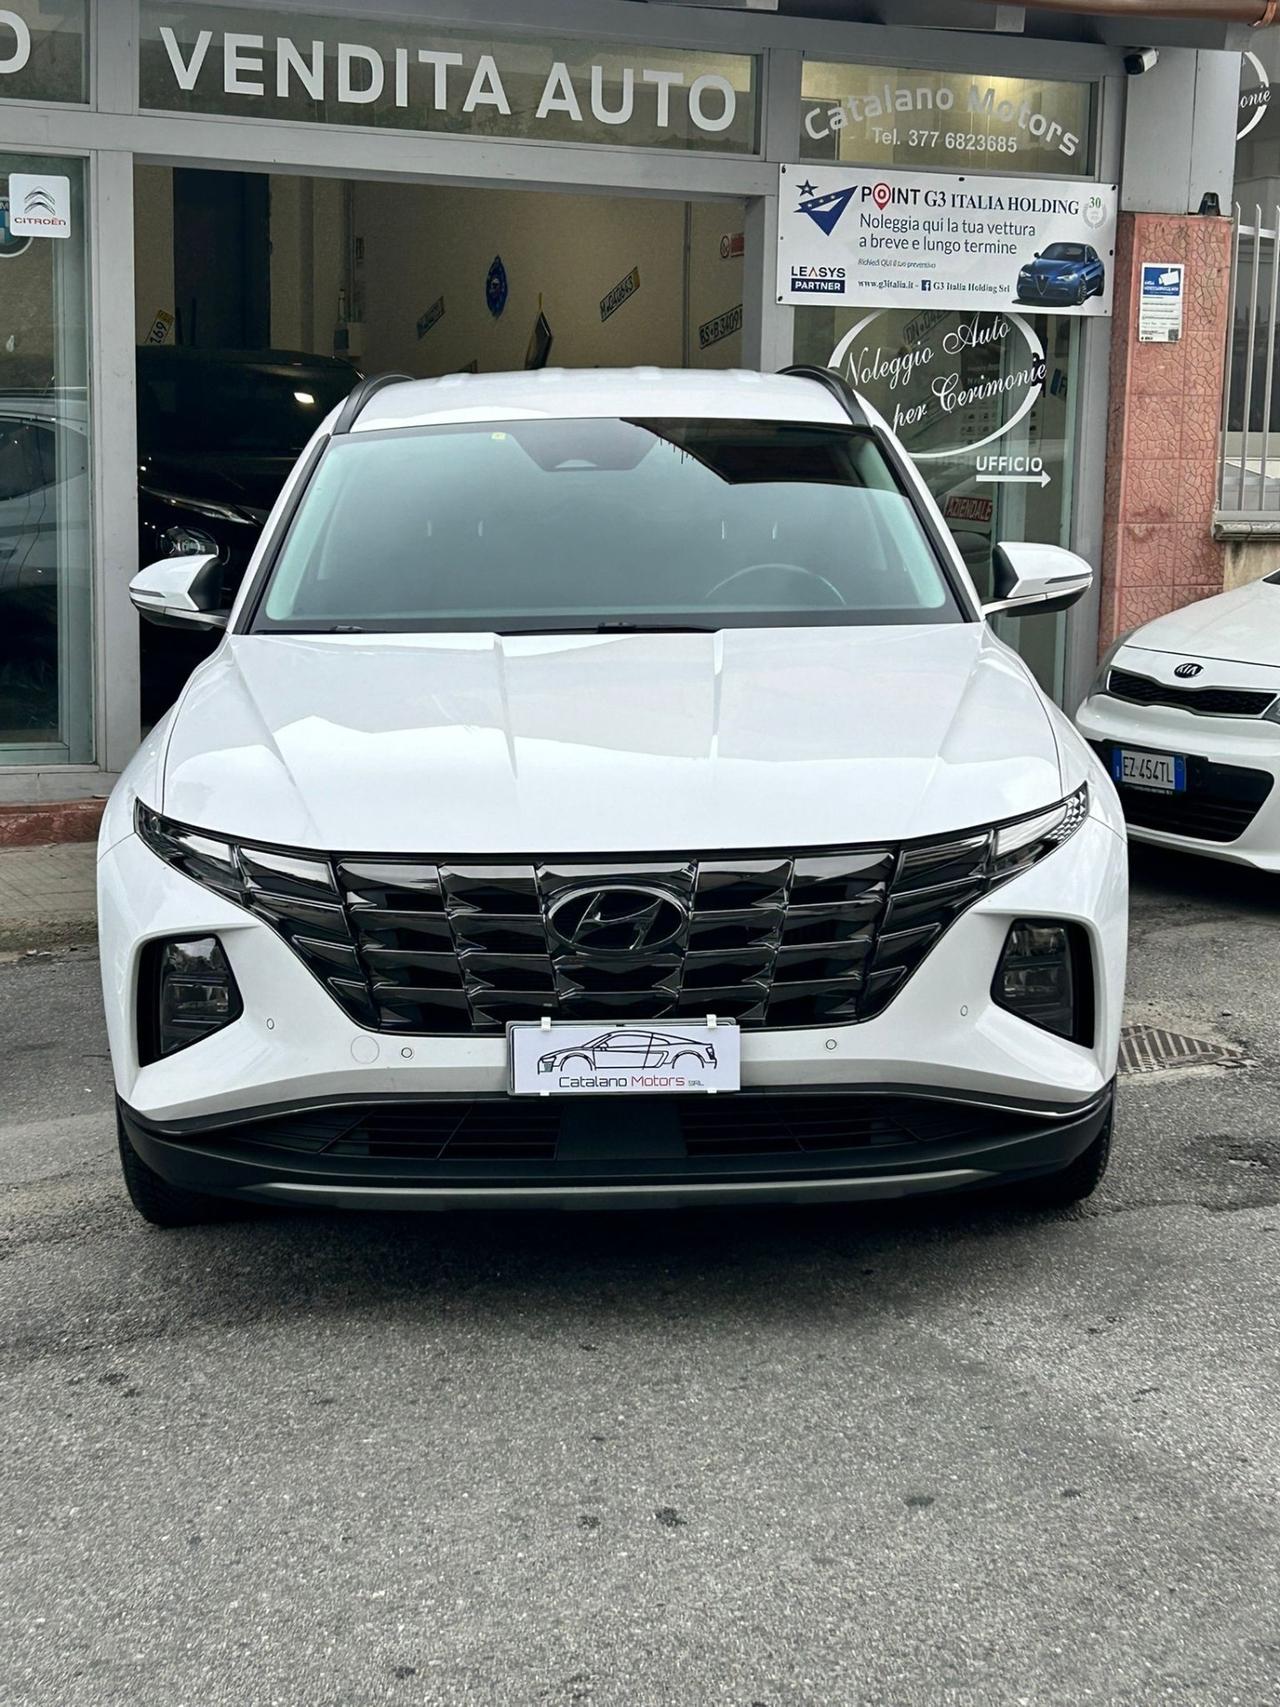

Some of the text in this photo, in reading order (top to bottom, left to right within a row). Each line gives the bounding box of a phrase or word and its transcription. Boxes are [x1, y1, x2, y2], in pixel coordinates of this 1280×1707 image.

[160, 27, 736, 132] VENDITA AUTO
[804, 84, 1079, 157] Catalano Motors
[870, 128, 1017, 153] Tel. 377 6823685
[861, 183, 921, 210] POINT
[924, 190, 946, 208] G3
[951, 193, 1005, 211] ITALIA
[1008, 197, 1079, 215] HOLDING
[1089, 196, 1102, 208] 30
[860, 213, 1036, 237] Noleggia qui la tua vettura
[859, 233, 1018, 255] a breve e lungo termine
[791, 266, 846, 279] LEASYS
[794, 280, 842, 292] PARTNER
[933, 281, 944, 290] G3
[946, 282, 966, 290] Italia
[968, 283, 998, 294] Holding
[845, 311, 1011, 390] Noleggio Auto
[892, 403, 928, 433] per
[931, 358, 1047, 413] Cerimonie
[976, 456, 1043, 472] UFFICIO
[946, 498, 992, 520] AZIENDALE
[1176, 664, 1198, 676] KIA
[559, 1076, 628, 1088] Catalano
[631, 1075, 685, 1087] Motors
